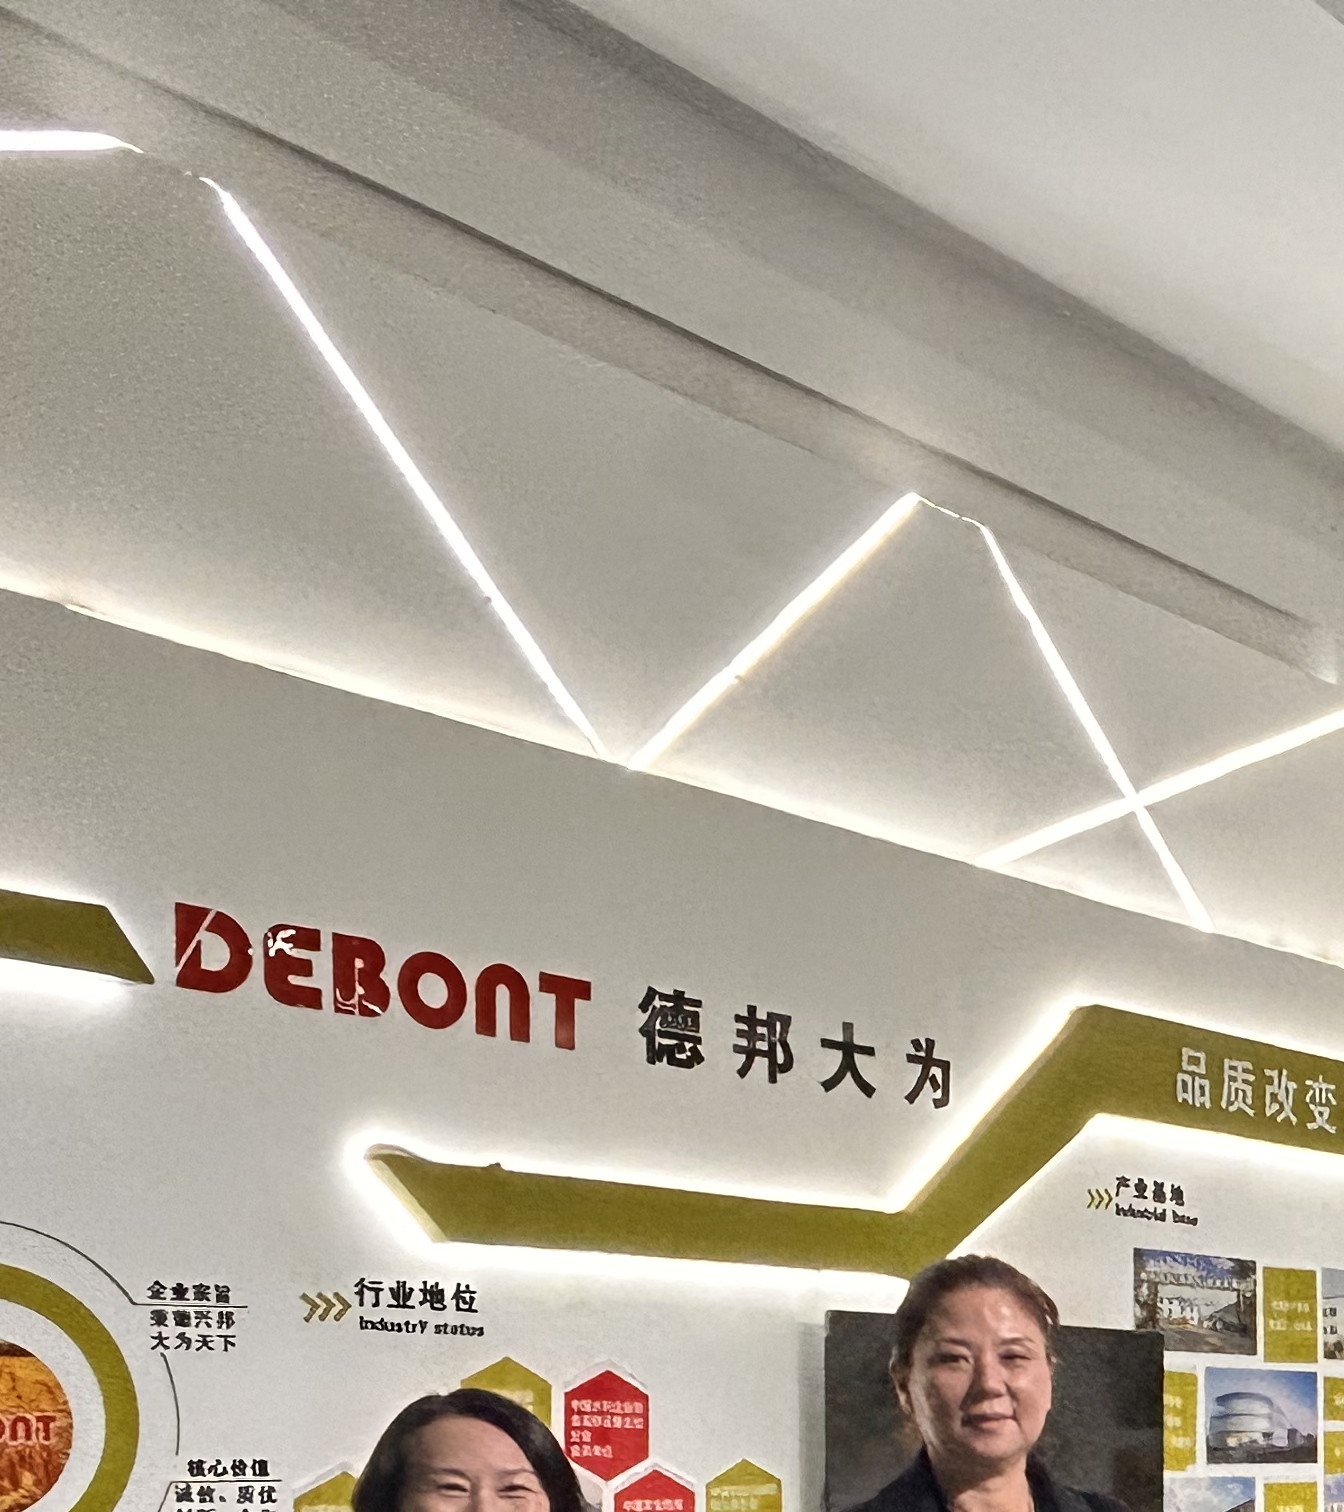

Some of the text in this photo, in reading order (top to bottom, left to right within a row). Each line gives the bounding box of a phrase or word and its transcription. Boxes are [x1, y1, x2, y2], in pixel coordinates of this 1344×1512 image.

[174, 901, 592, 1051] DEBONT
[637, 984, 951, 1109] 德邦大为
[1115, 1175, 1185, 1207] 产业基地
[354, 1277, 479, 1313] 行业地位
[359, 1316, 427, 1334] Industry
[150, 1331, 237, 1352] 大为天下
[187, 1458, 270, 1478] 核心价值
